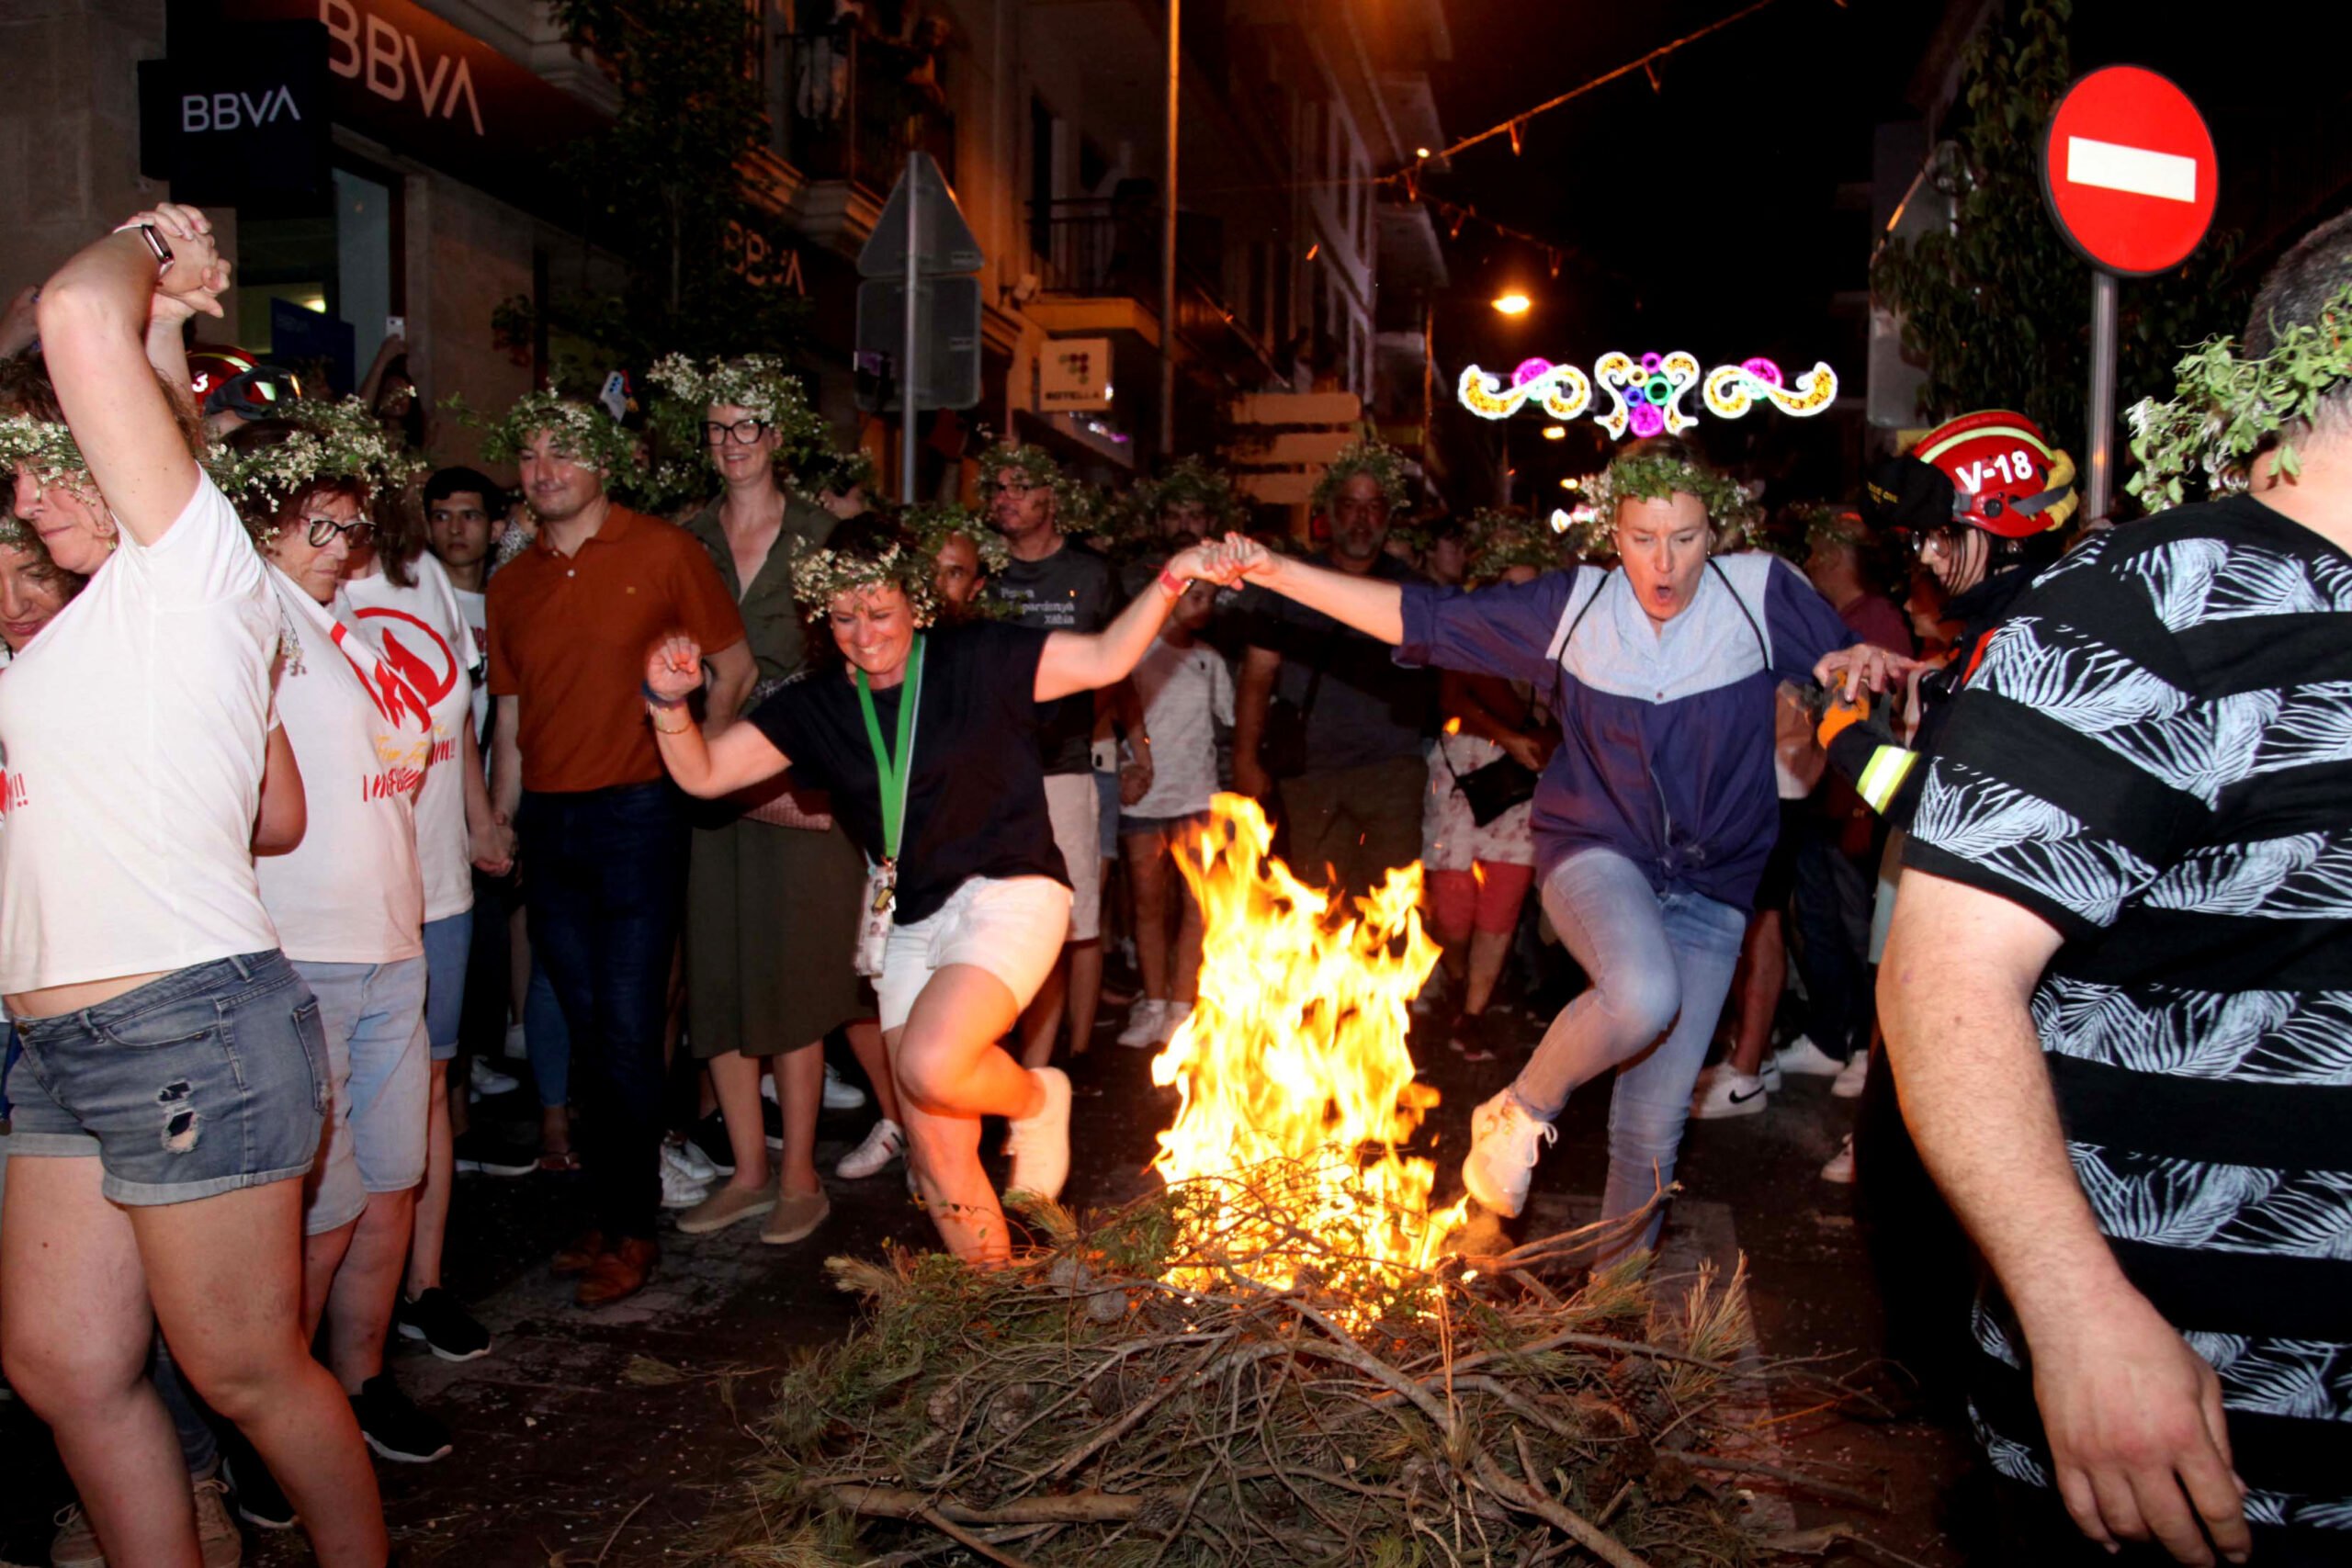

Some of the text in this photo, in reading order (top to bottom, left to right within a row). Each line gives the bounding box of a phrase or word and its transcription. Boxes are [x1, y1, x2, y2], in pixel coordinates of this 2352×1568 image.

[320, 0, 484, 136] BBVA
[182, 85, 301, 132] BBVA
[1954, 450, 2033, 494] V-18
